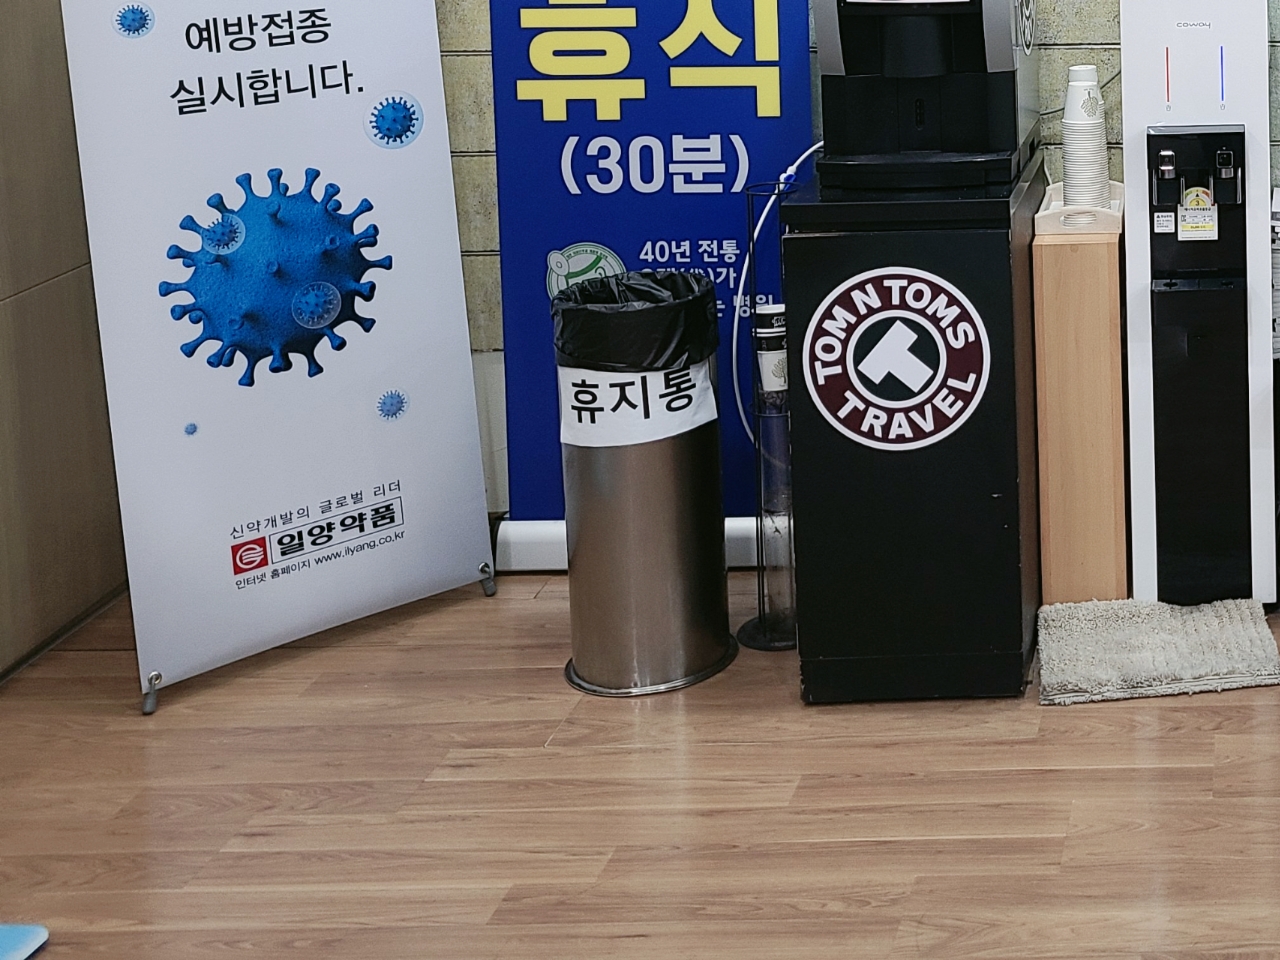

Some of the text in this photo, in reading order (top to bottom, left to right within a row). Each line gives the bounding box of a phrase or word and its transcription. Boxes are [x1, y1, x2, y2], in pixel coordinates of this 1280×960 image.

[184, 8, 332, 54] 예방접종
[1176, 22, 1211, 30] coway
[169, 59, 365, 116] 실시합니다.
[560, 133, 750, 196] (30분)
[639, 239, 741, 263] 40년 전통
[814, 278, 976, 386] TOM N TOMS
[570, 366, 698, 425] 휴지통
[836, 370, 977, 440] TRAVEL
[230, 480, 401, 540] 신약개발의 글로벌 리더
[276, 502, 396, 557] 일양약품
[235, 530, 406, 590] 인터넷 홈페이지 www.ilyang.co.kr
